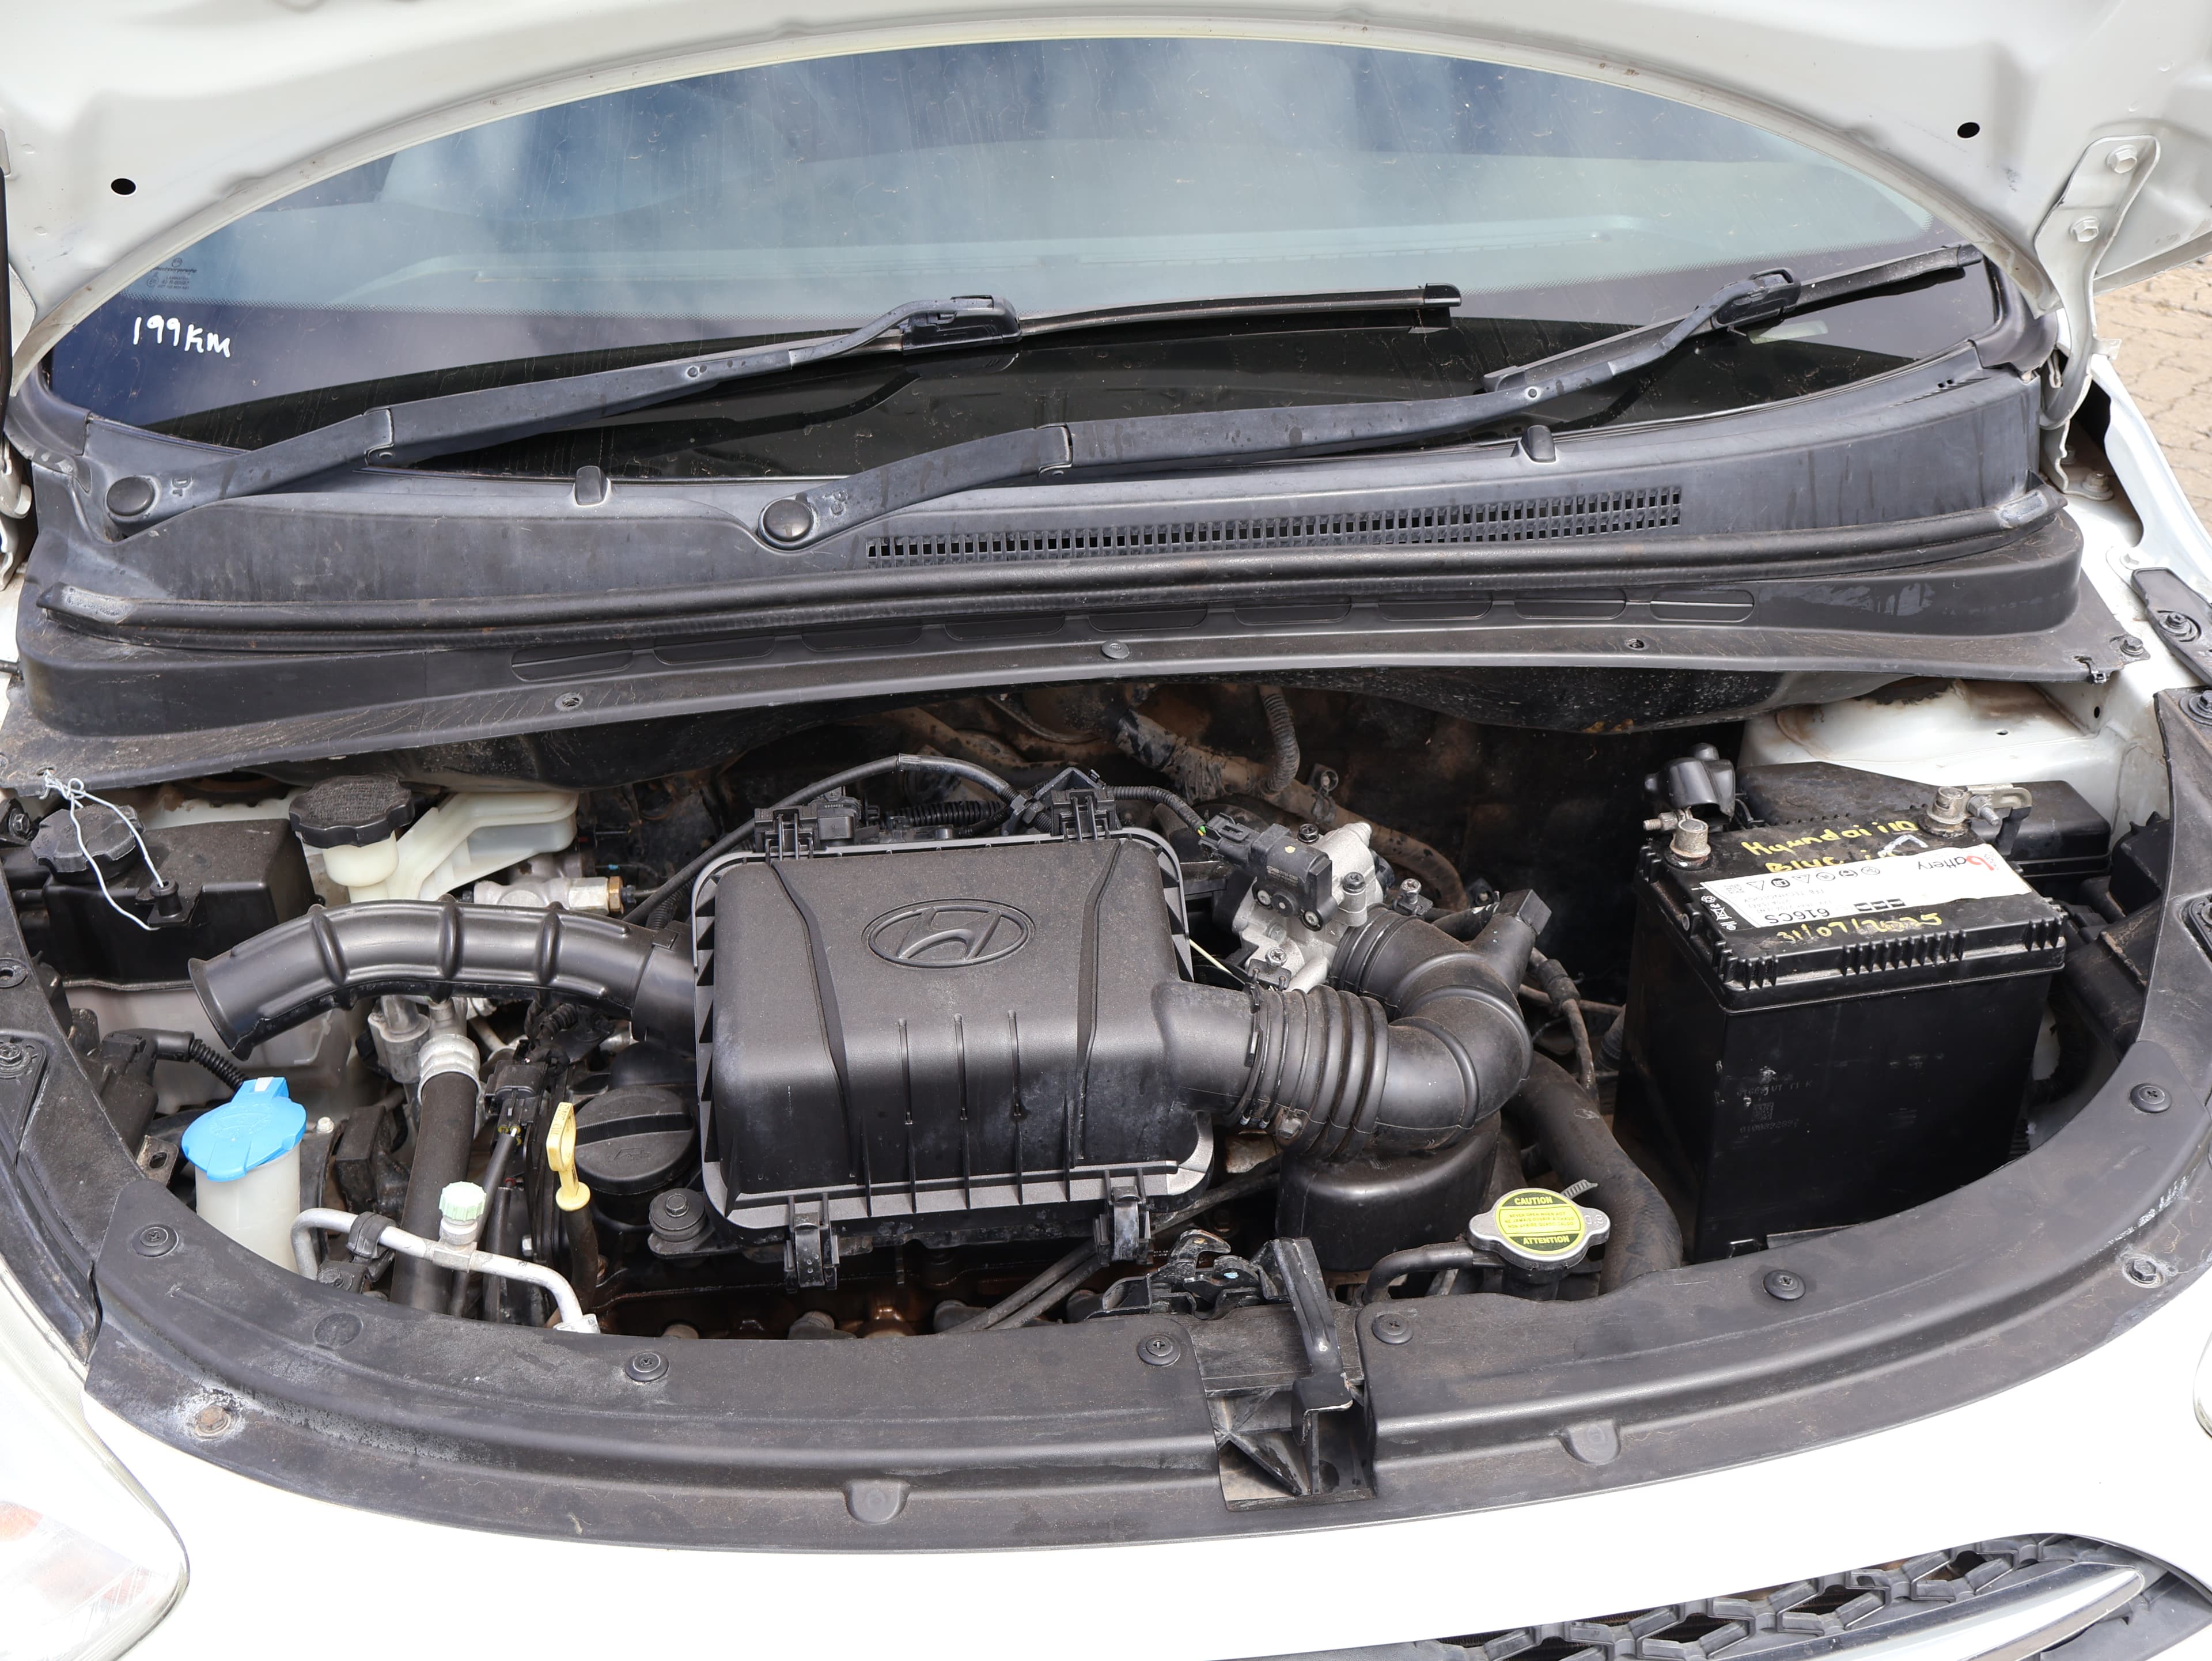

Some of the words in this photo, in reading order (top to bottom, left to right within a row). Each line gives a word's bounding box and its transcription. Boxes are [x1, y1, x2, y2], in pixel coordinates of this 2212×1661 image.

[1741, 824, 1872, 856] Hyundai
[1918, 855, 1995, 871] battery
[1764, 908, 1830, 924] 616CS
[1514, 1196, 1554, 1205] CAUTION
[1522, 1235, 1570, 1244] ATTENTION
